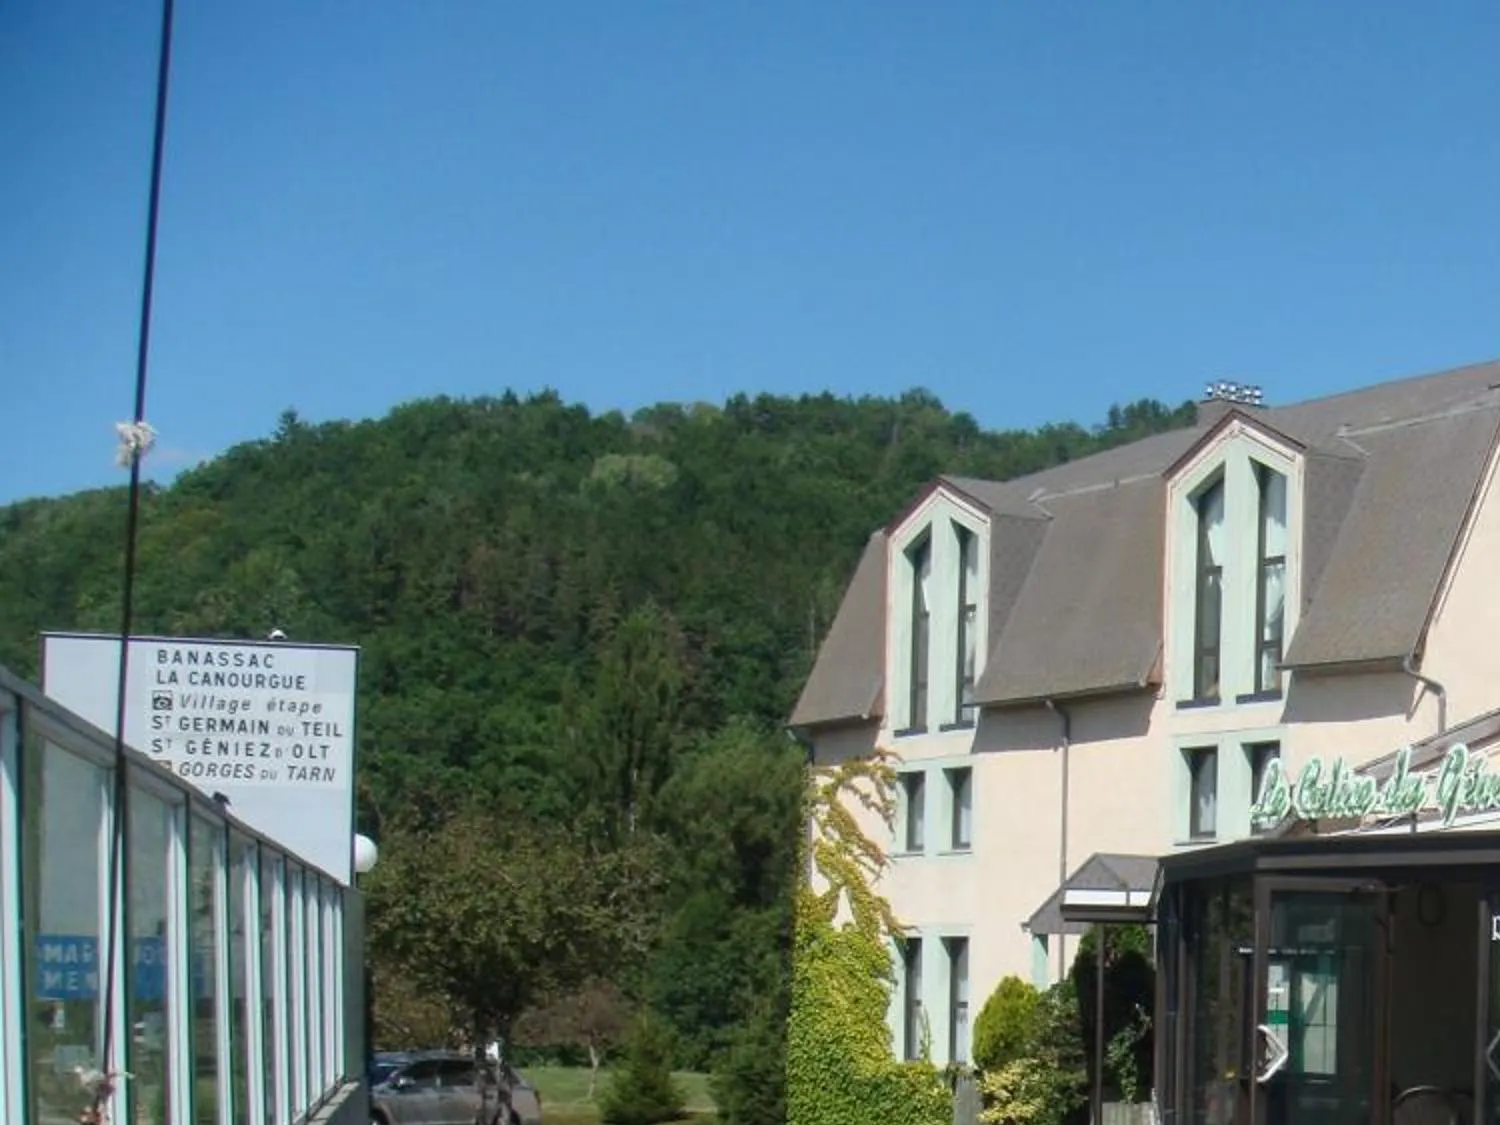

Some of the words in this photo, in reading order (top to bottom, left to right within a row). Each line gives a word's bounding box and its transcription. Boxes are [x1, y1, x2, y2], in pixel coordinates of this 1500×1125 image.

[157, 649, 275, 668] BANASSAC
[156, 670, 179, 685] LA
[188, 671, 306, 690] CANOURGUE
[179, 693, 252, 714] Village
[266, 697, 323, 716] étape
[179, 717, 270, 735] GERMAIN
[277, 726, 295, 736] DU
[301, 721, 343, 737] TEIL
[179, 761, 255, 779] GORGES
[260, 769, 277, 780] DU
[287, 765, 337, 782] TARN
[1249, 757, 1291, 822] Le
